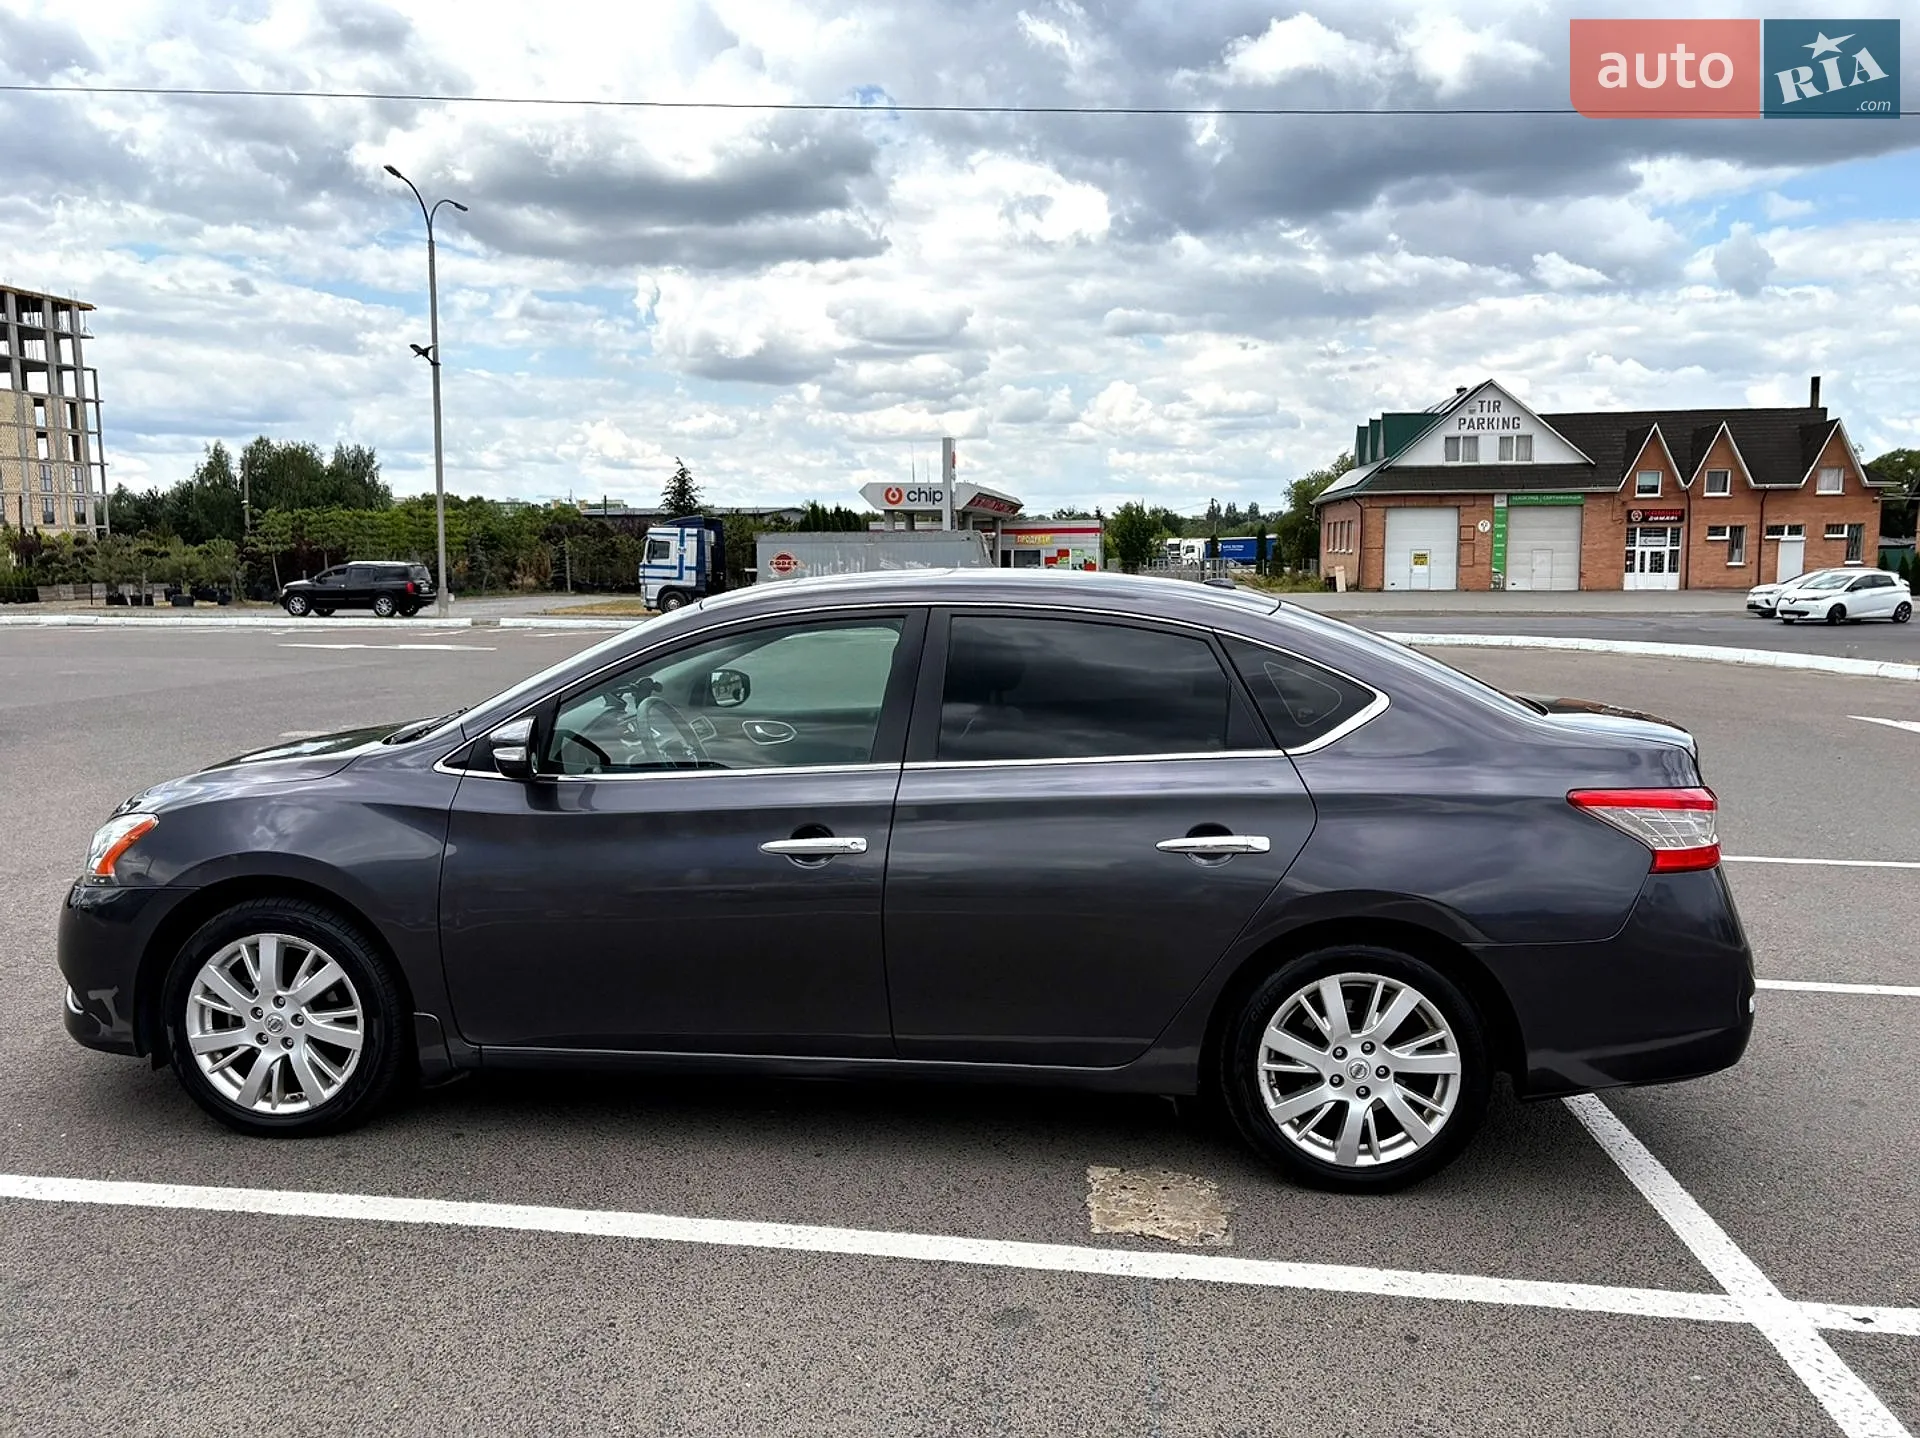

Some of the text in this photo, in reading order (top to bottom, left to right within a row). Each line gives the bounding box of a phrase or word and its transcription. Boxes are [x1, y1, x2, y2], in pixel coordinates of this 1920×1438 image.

[1478, 400, 1502, 413] TIR
[1458, 416, 1521, 430] PARKING
[906, 487, 943, 505] chip
